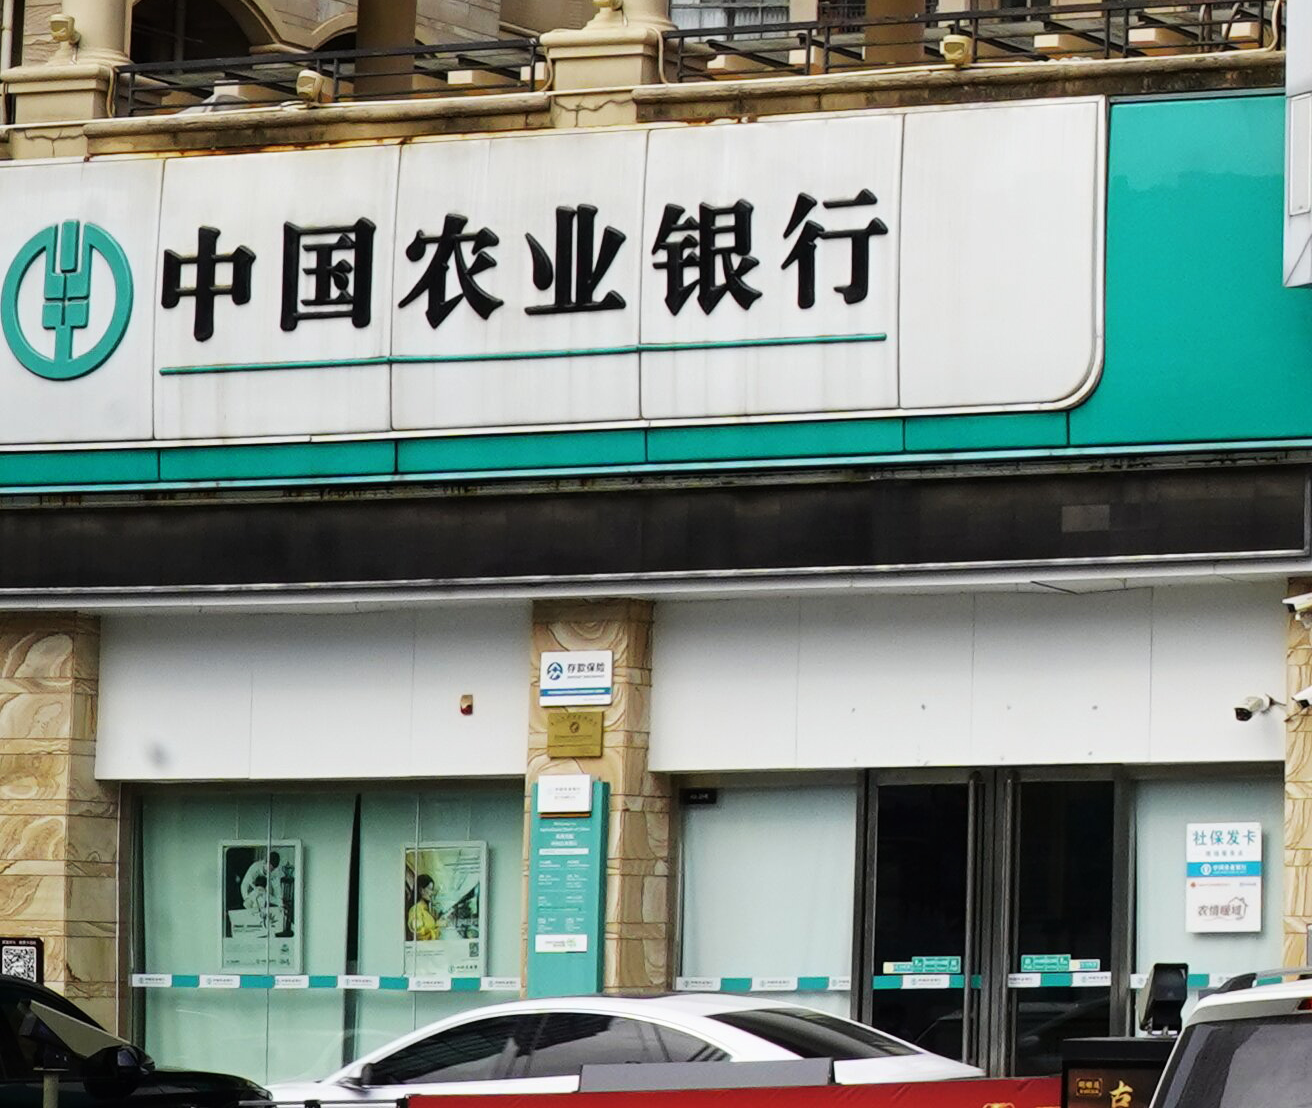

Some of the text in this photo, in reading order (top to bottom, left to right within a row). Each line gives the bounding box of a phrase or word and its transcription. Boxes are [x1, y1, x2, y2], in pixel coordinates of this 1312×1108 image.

[160, 187, 889, 343] 中国农业银行
[1192, 829, 1256, 846] 社保发卡
